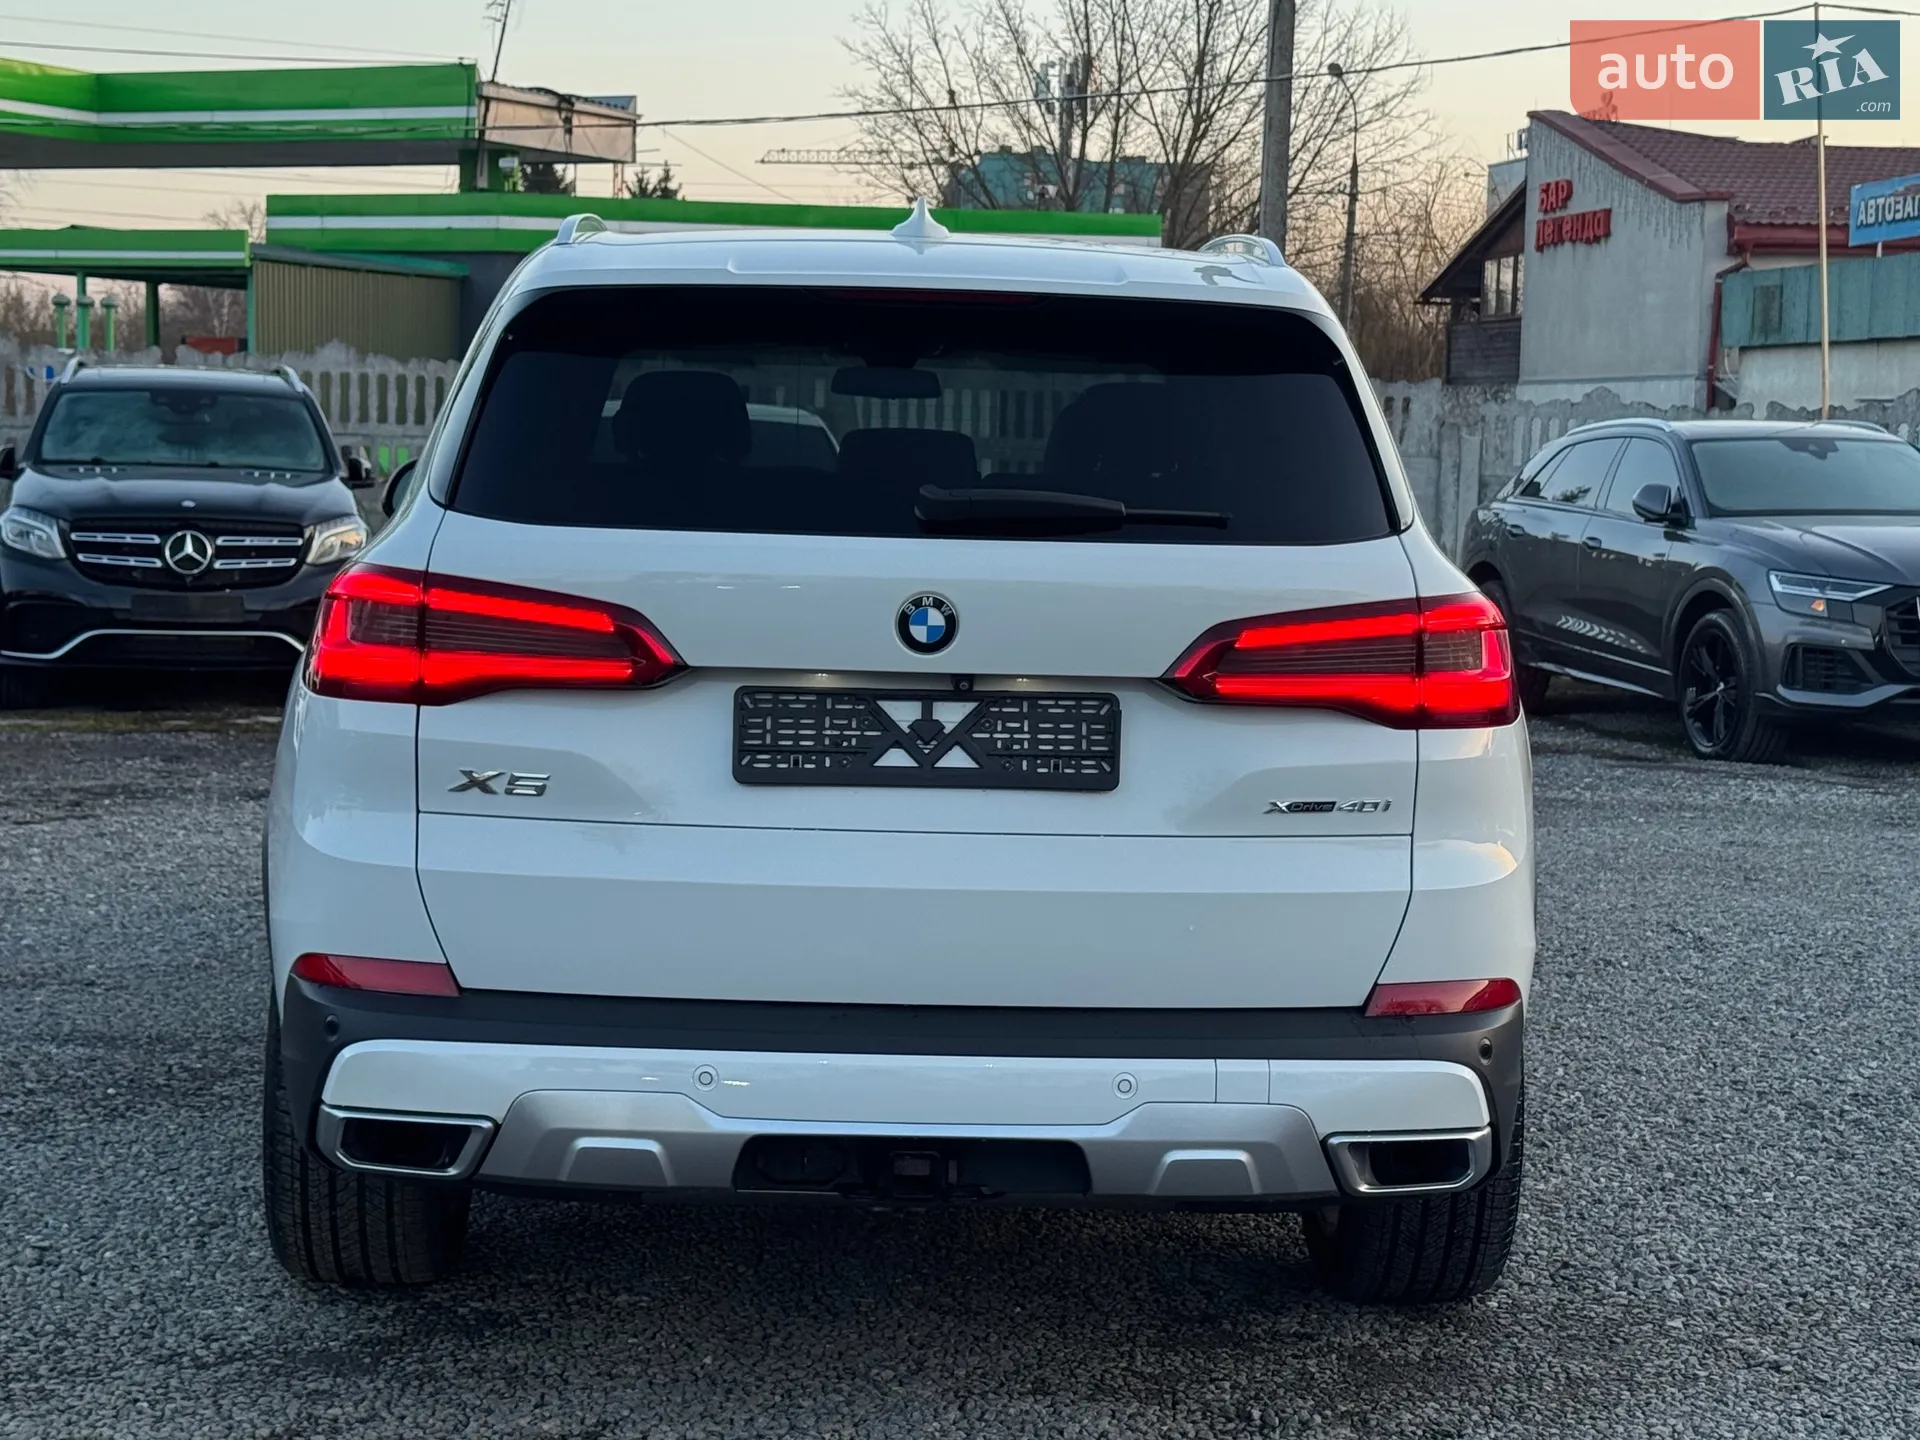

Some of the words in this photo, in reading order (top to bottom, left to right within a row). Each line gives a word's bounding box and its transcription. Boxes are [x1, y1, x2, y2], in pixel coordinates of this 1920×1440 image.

[1538, 179, 1573, 213] БАР
[904, 596, 953, 616] BMW
[447, 770, 552, 797] X5
